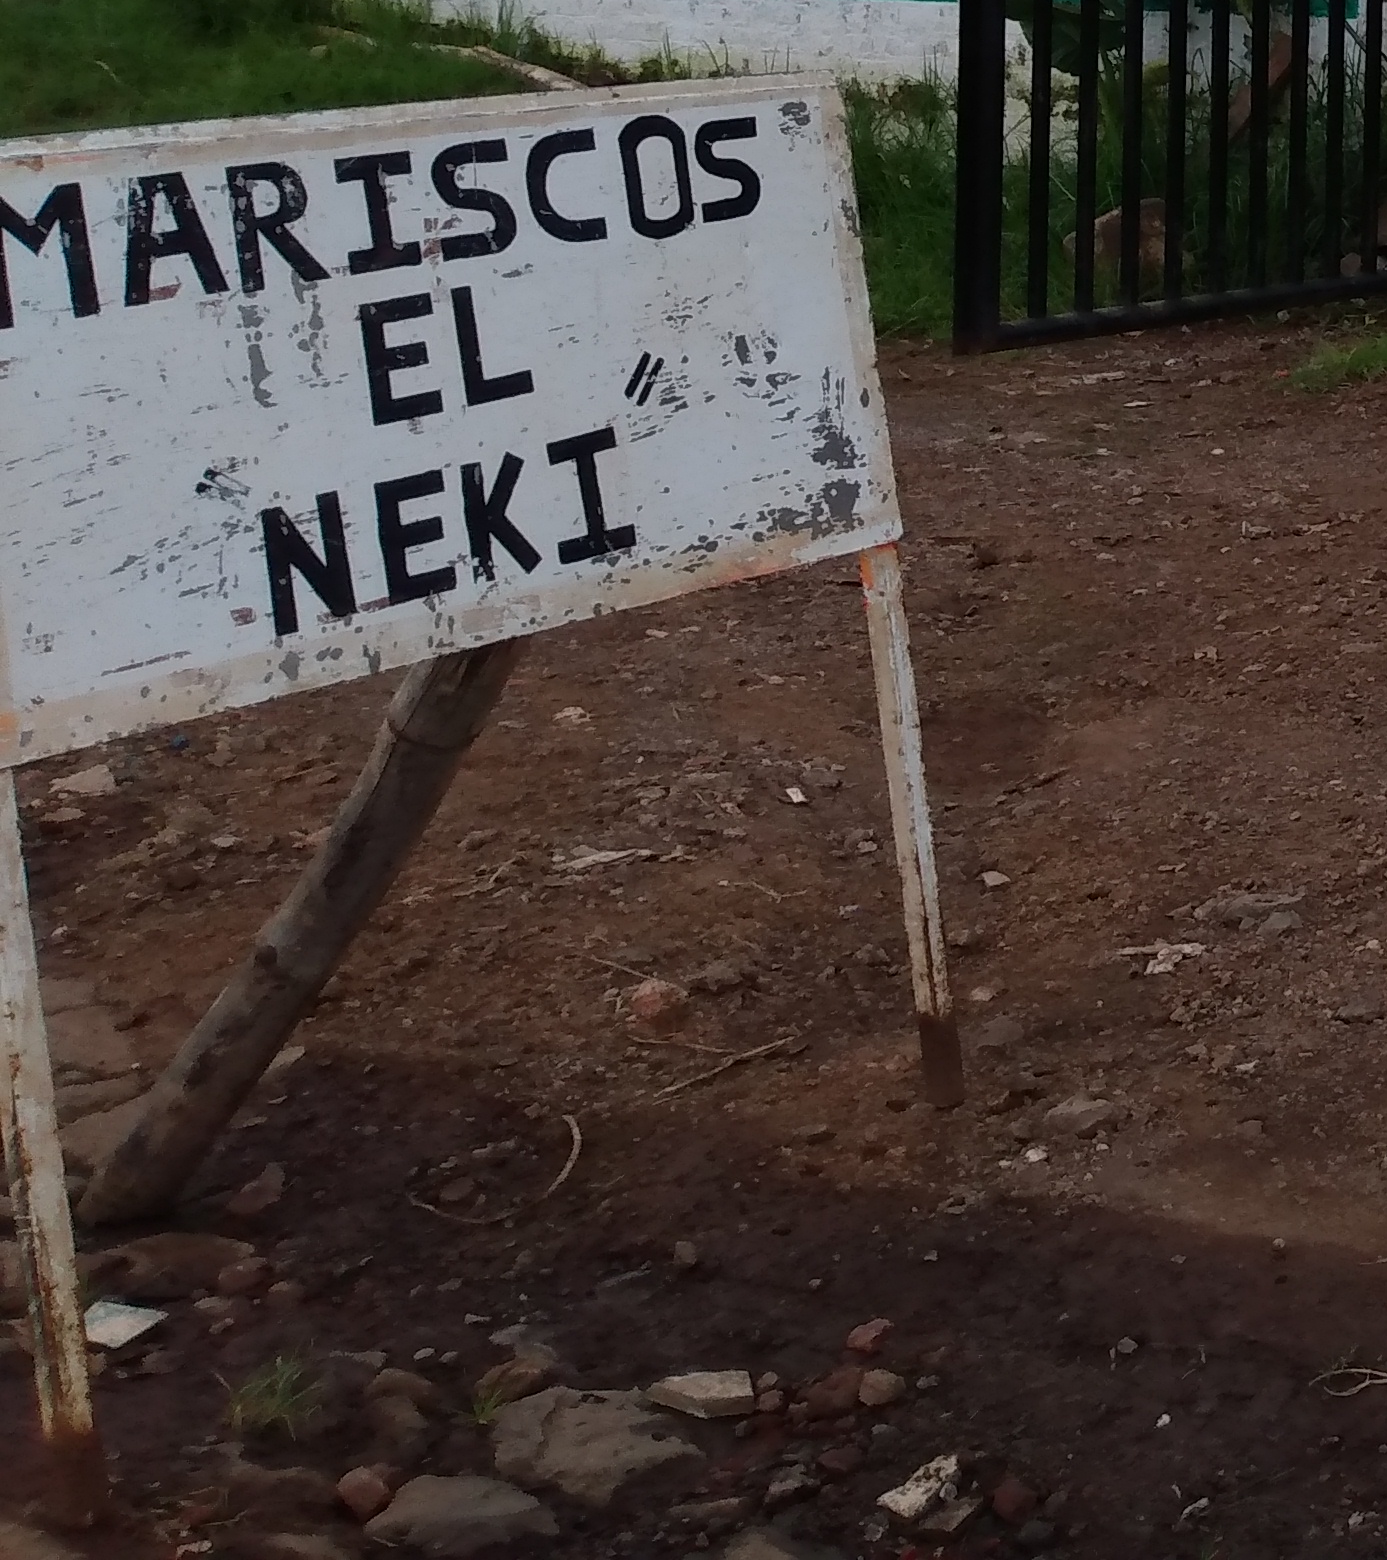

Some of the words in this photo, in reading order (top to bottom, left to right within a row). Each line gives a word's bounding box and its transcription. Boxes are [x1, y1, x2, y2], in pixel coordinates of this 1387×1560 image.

[0, 114, 763, 330] MARISCOS
[358, 287, 535, 427] EL
[260, 427, 637, 638] NEKI
